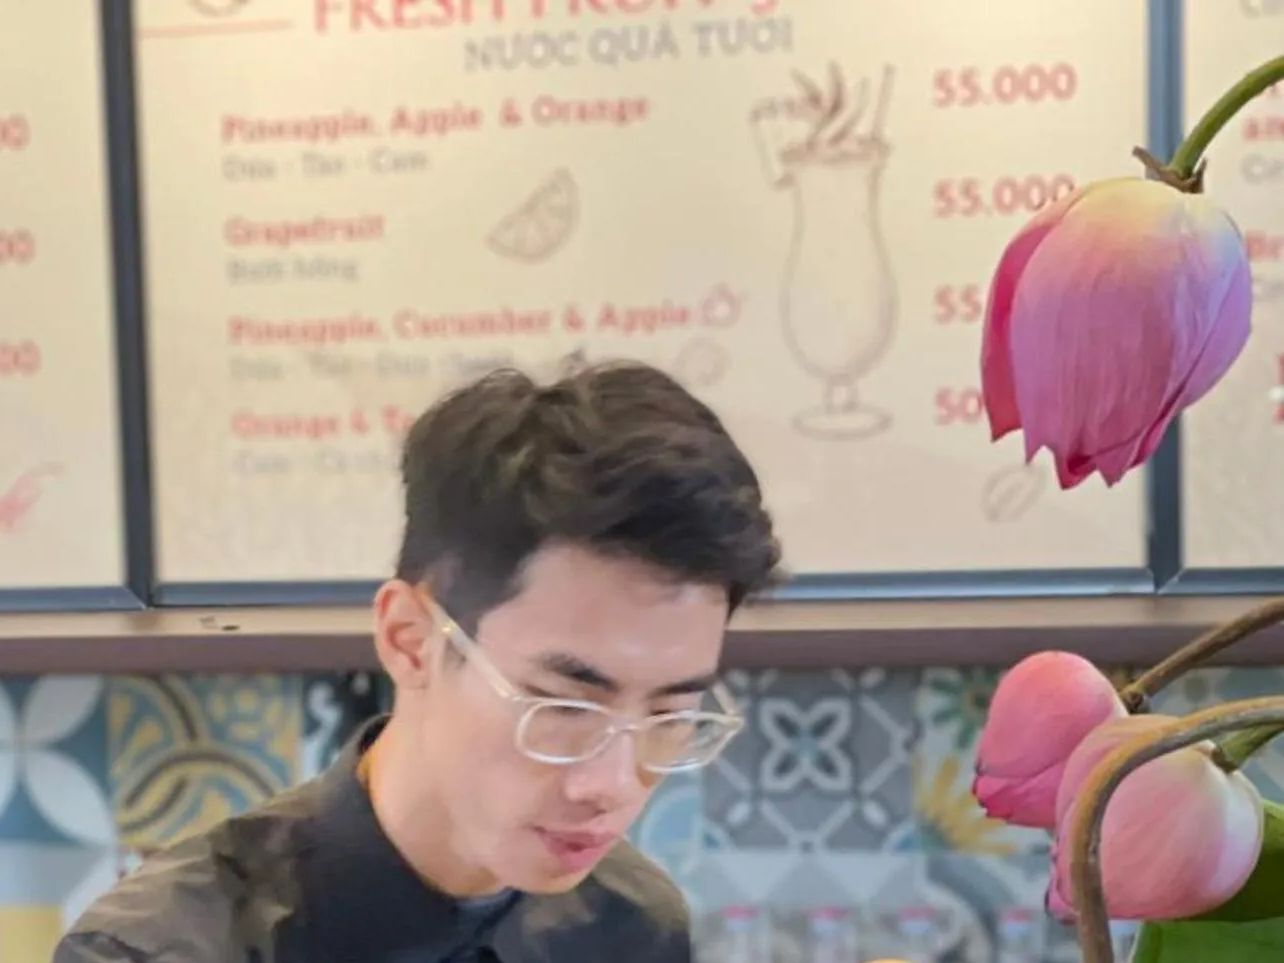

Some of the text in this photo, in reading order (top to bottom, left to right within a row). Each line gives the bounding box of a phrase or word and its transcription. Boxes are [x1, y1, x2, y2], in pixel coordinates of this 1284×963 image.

[933, 63, 1077, 109] 55.000
[390, 104, 482, 138] Apple
[500, 99, 523, 128] &
[532, 96, 650, 128] Orange
[224, 215, 384, 250] Grapefruit
[562, 306, 585, 334] &
[599, 302, 692, 336] Apple
[230, 409, 341, 442] Orange
